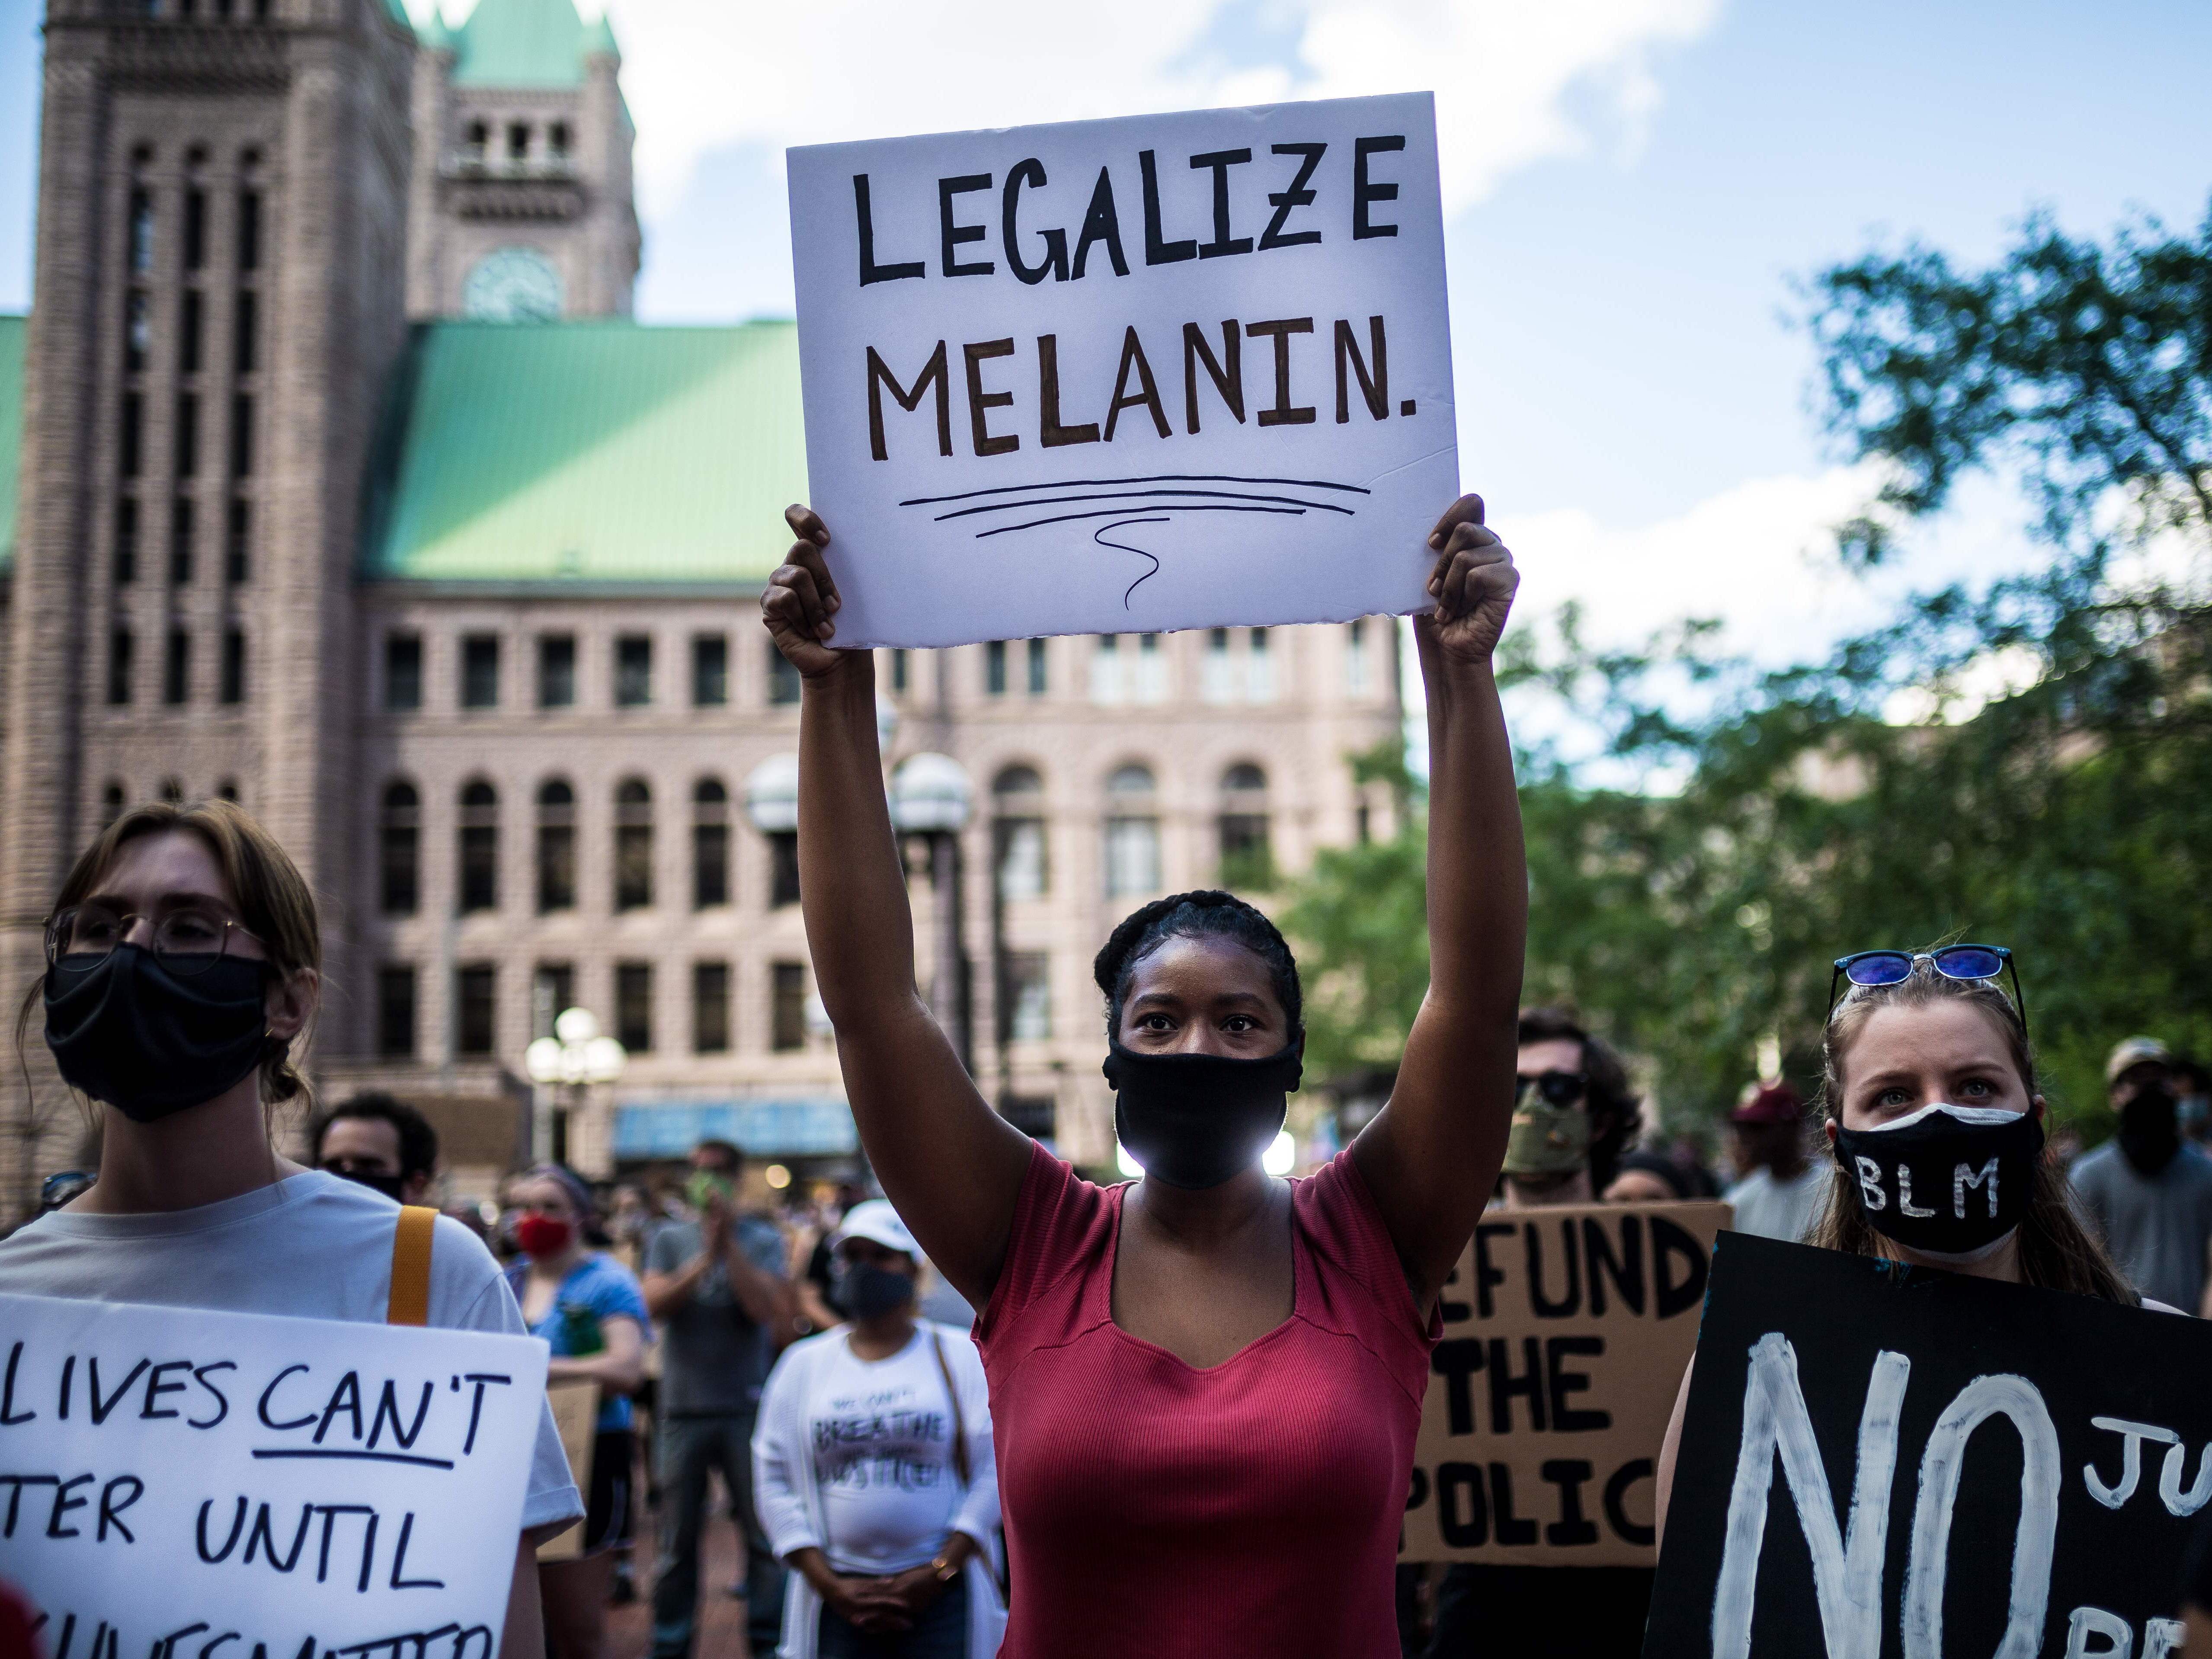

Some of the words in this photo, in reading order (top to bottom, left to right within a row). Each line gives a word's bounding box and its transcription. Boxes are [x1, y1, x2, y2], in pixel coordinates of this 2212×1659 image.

[853, 135, 1406, 287] LEGALIZE
[866, 315, 1417, 461] MELANIN.
[1854, 1155, 1999, 1219] BLM
[0, 1341, 237, 1429] LIVES
[257, 1363, 512, 1455] CAN'T
[1431, 1336, 1612, 1435] THE
[0, 1472, 144, 1544] TER
[196, 1496, 445, 1593] UNTIL
[1712, 1332, 2062, 1659] NO
